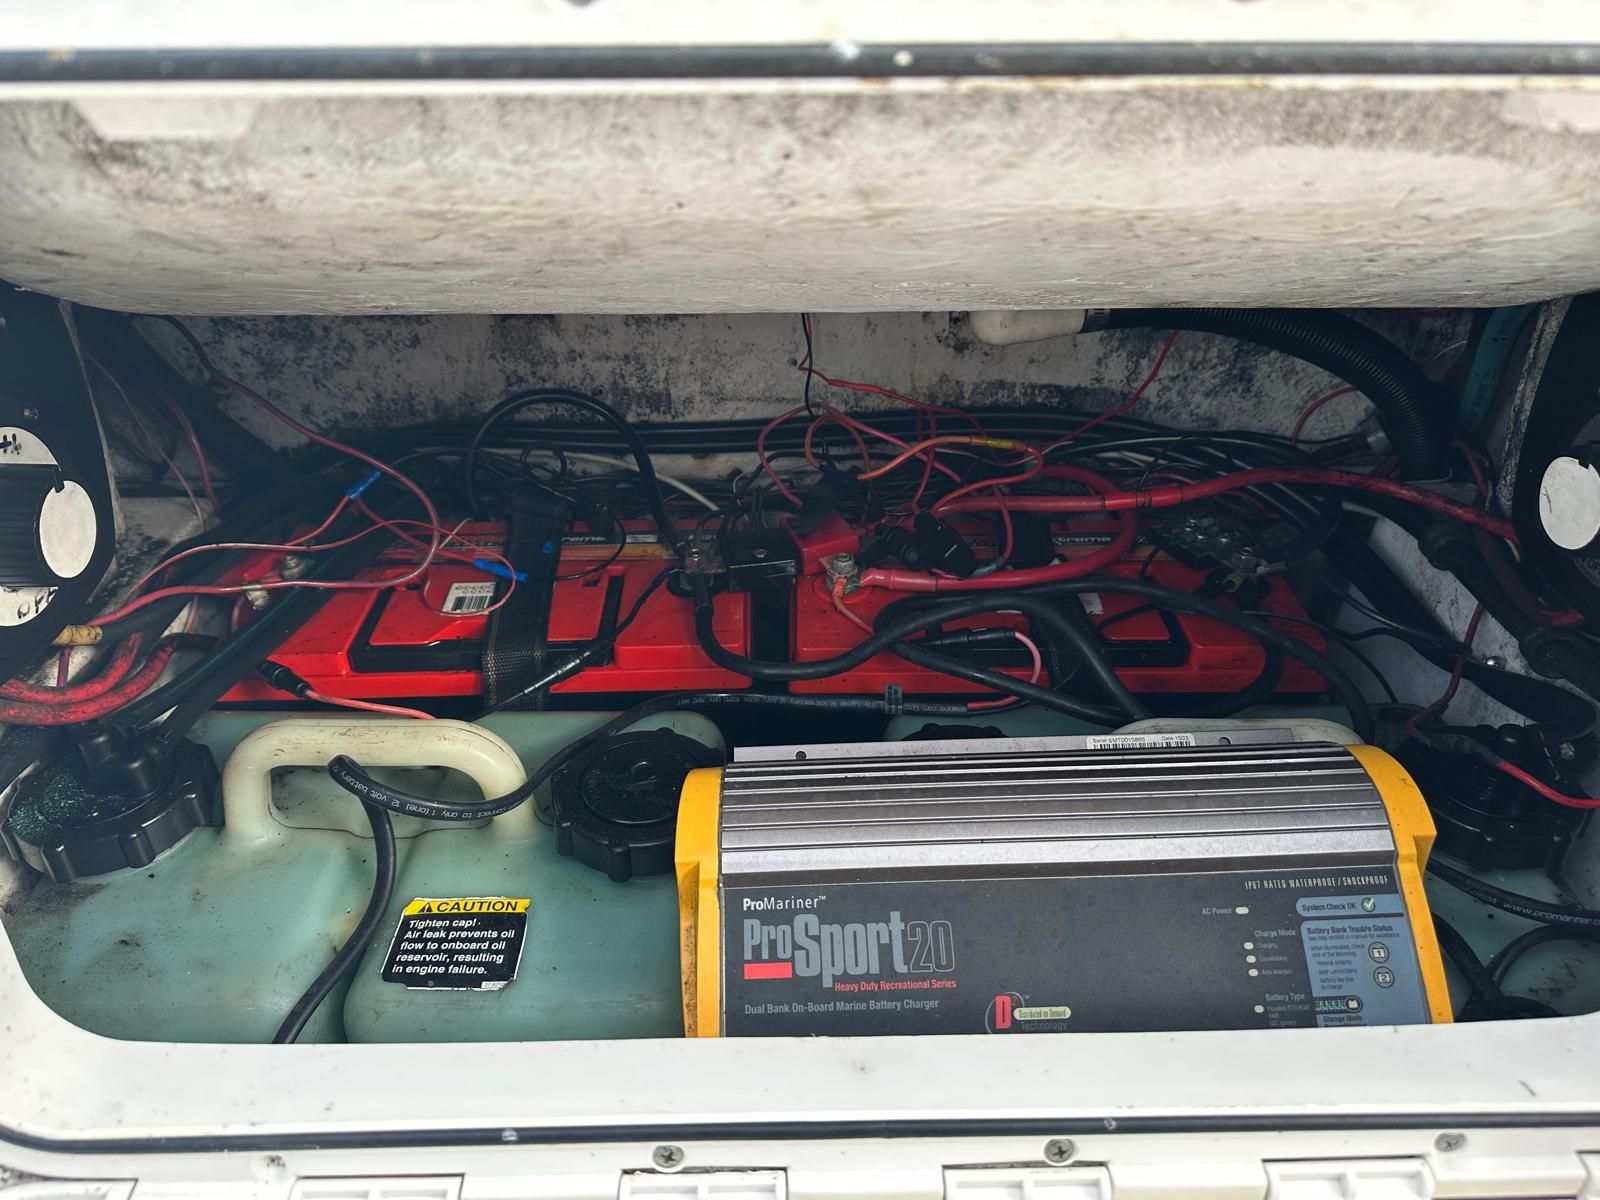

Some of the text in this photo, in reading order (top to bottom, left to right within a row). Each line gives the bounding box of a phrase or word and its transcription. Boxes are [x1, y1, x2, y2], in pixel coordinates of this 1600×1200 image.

[339, 771, 369, 795] battery
[369, 788, 388, 802] volt
[440, 809, 459, 819] only
[1264, 879, 1287, 889] RATED
[1288, 877, 1336, 888] WATERPROOF
[1342, 875, 1389, 886] SHOCKPROOF
[436, 900, 518, 913] CAUTION
[1201, 907, 1232, 915] AC Power
[1302, 902, 1357, 912] System Check OK
[409, 918, 477, 930] Tighten cap!
[1306, 927, 1330, 935] Battery
[1331, 926, 1347, 934] Bank
[1348, 925, 1372, 933] Trouble
[404, 929, 515, 942] Air leak prevents oil
[1254, 928, 1297, 938] Charge Mode
[400, 941, 506, 950] flow to onboard oil
[396, 952, 504, 964] reservoir, resulting
[392, 964, 488, 976] in engine failure.
[834, 978, 957, 992] Heavy Duty Recreational Series
[1265, 992, 1305, 1001] Battery Type
[744, 998, 939, 1015] Dual Bank On-Board Marine Battery Charger
[1323, 1014, 1362, 1023] Storage Mode
[1020, 1021, 1068, 1032] Technology
